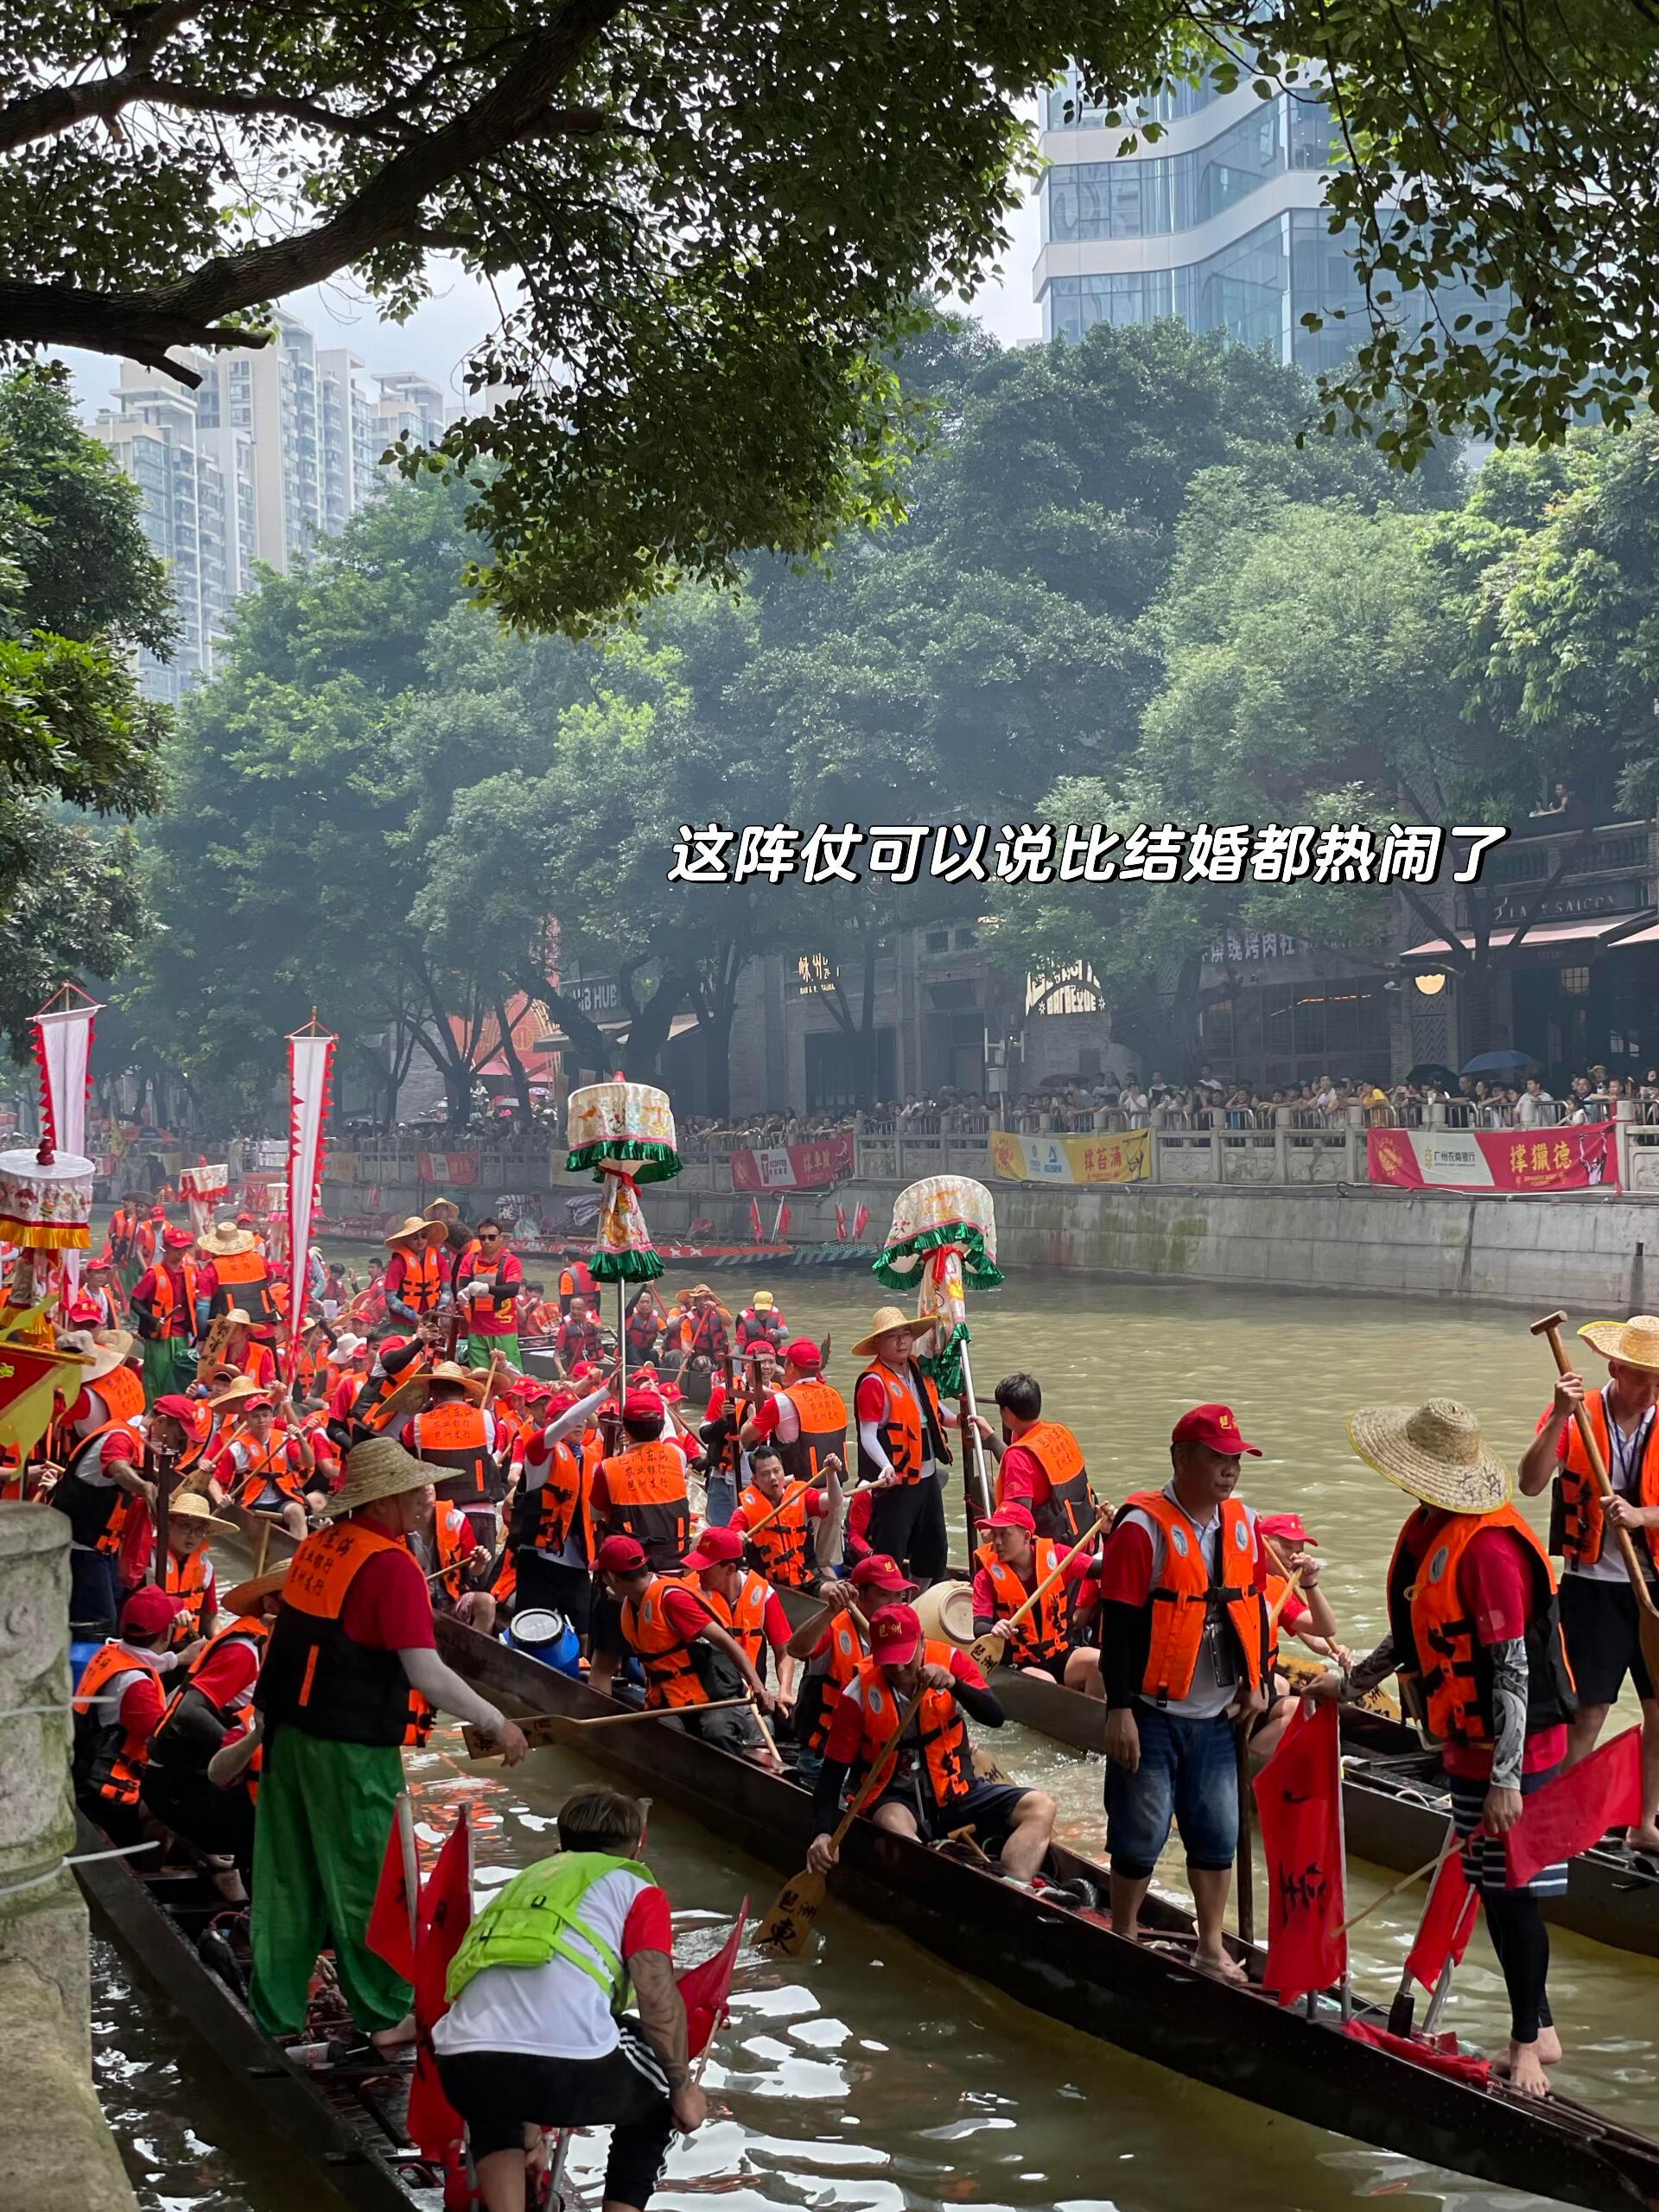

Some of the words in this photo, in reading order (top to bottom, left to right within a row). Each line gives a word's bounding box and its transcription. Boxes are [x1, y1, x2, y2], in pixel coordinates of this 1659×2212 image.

[1433, 1151, 1476, 1163] 广州农商银行
